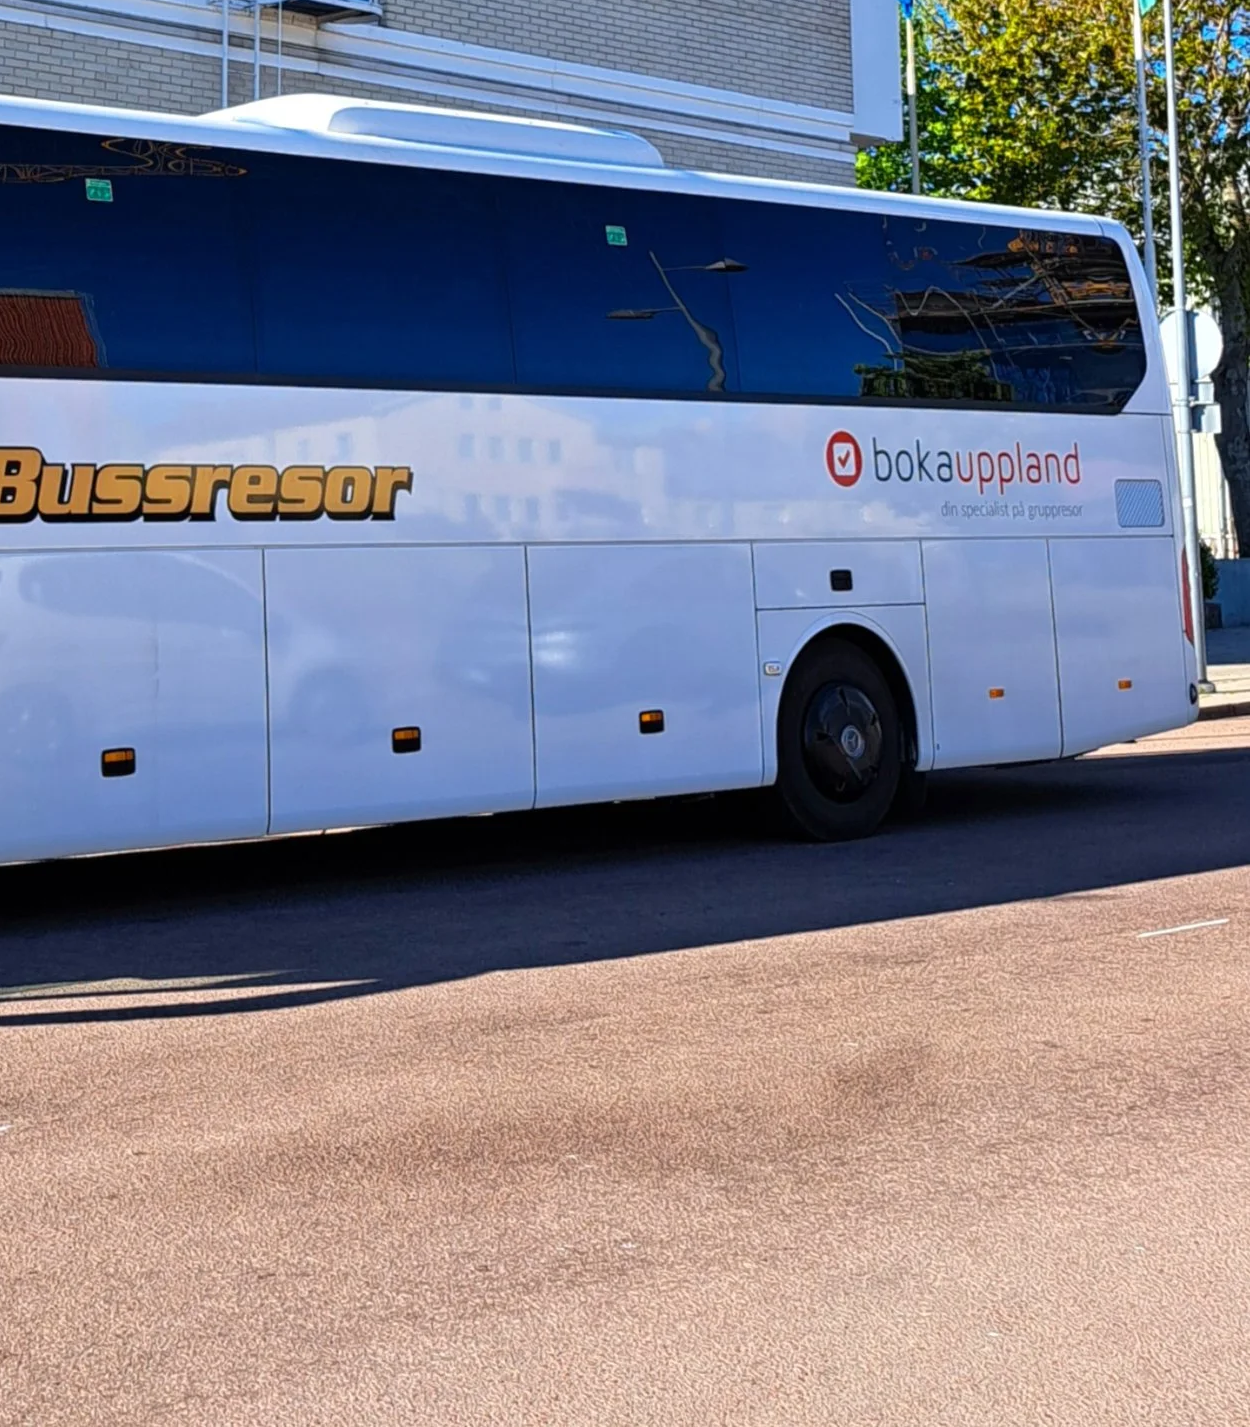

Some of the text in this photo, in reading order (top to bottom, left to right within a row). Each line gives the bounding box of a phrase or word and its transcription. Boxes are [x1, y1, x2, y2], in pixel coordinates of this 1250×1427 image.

[872, 437, 1082, 496] bokauppland
[940, 500, 1084, 521] din specialist på gruppresor
